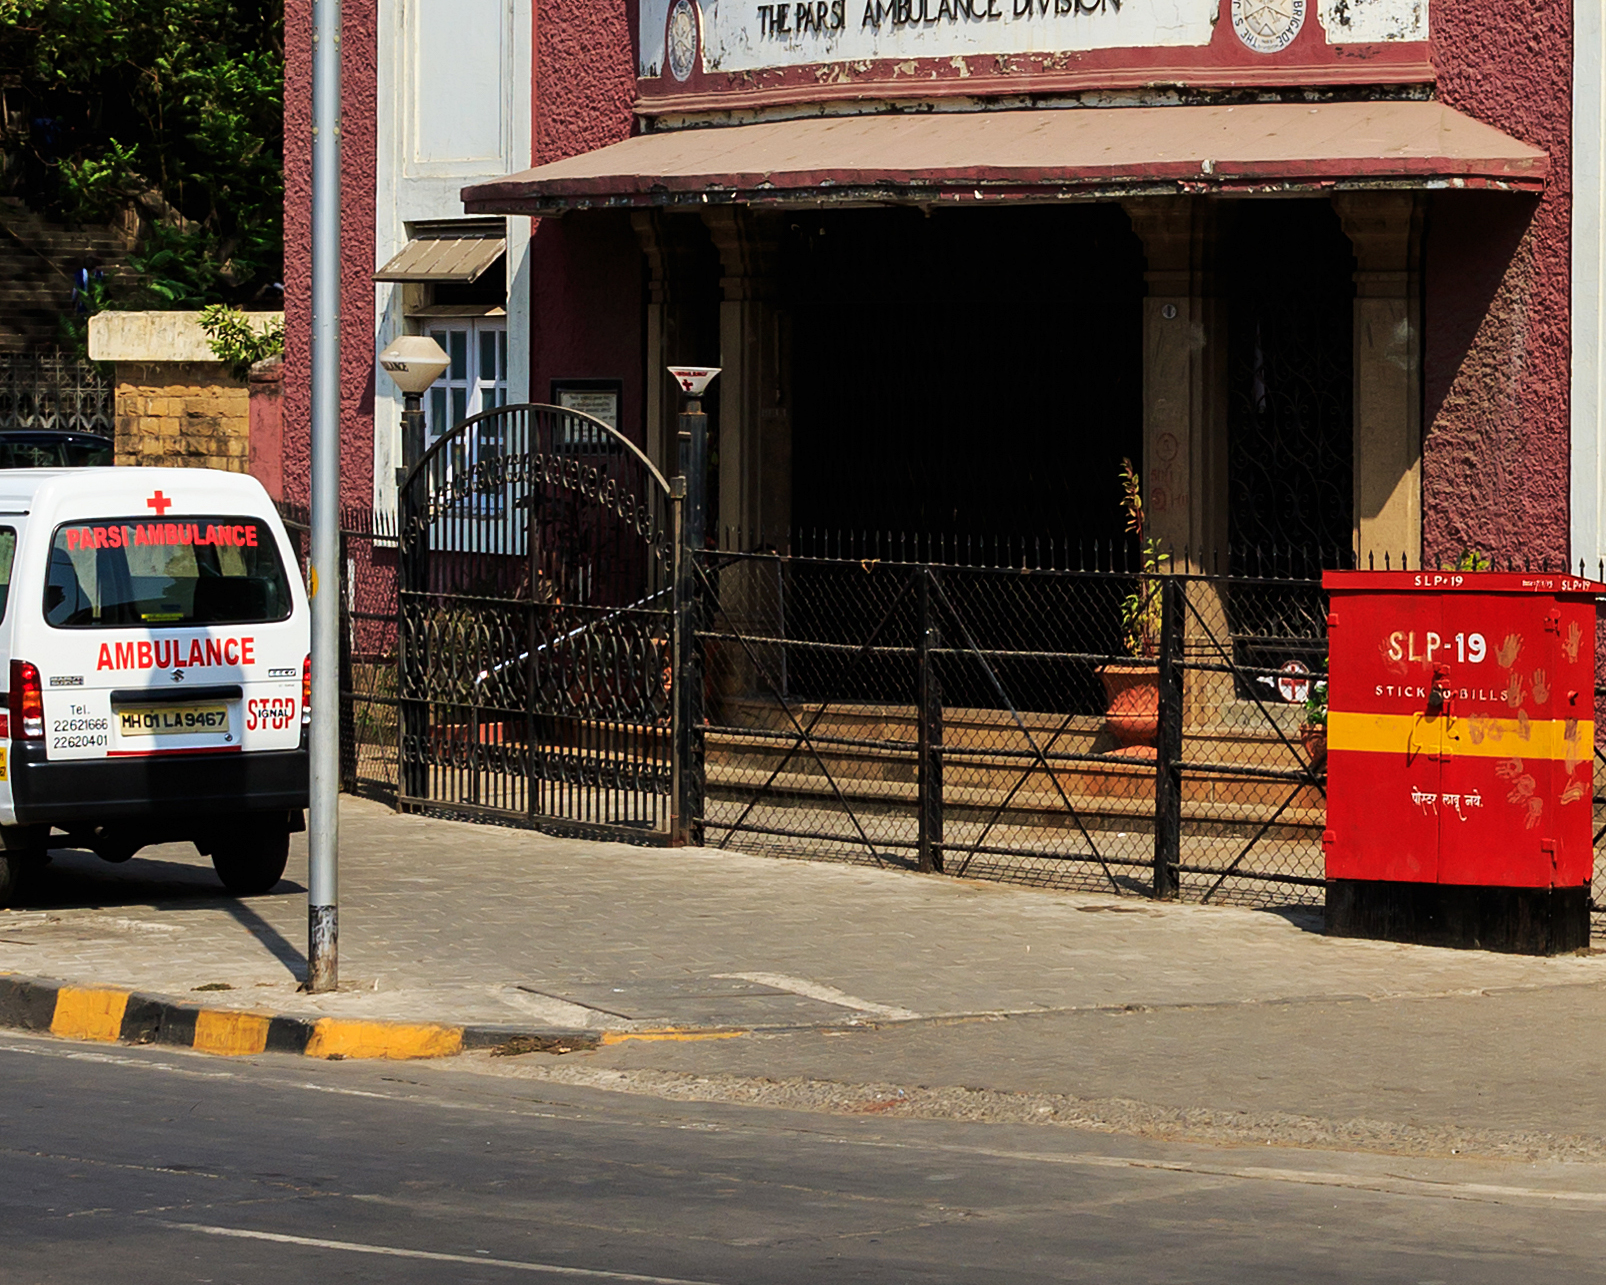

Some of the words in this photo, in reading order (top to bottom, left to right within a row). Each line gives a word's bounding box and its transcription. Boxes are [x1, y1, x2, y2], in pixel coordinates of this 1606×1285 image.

[757, 3, 791, 35] THE
[796, 0, 846, 34] PARSI
[1240, 28, 1258, 48] THE
[1276, 0, 1304, 48] BRIGADE
[66, 525, 129, 550] PARSI
[134, 523, 258, 547] AMBULANCE
[97, 637, 256, 670] AMBULANCE
[1388, 630, 1486, 663] SLP-19
[1375, 685, 1425, 698] STICK
[1460, 688, 1508, 701] BILLS
[70, 704, 90, 715] Tel.
[247, 698, 295, 731] STOP
[258, 709, 288, 718] IGNAL
[54, 718, 108, 732] 22621666
[53, 735, 108, 749] 22620401
